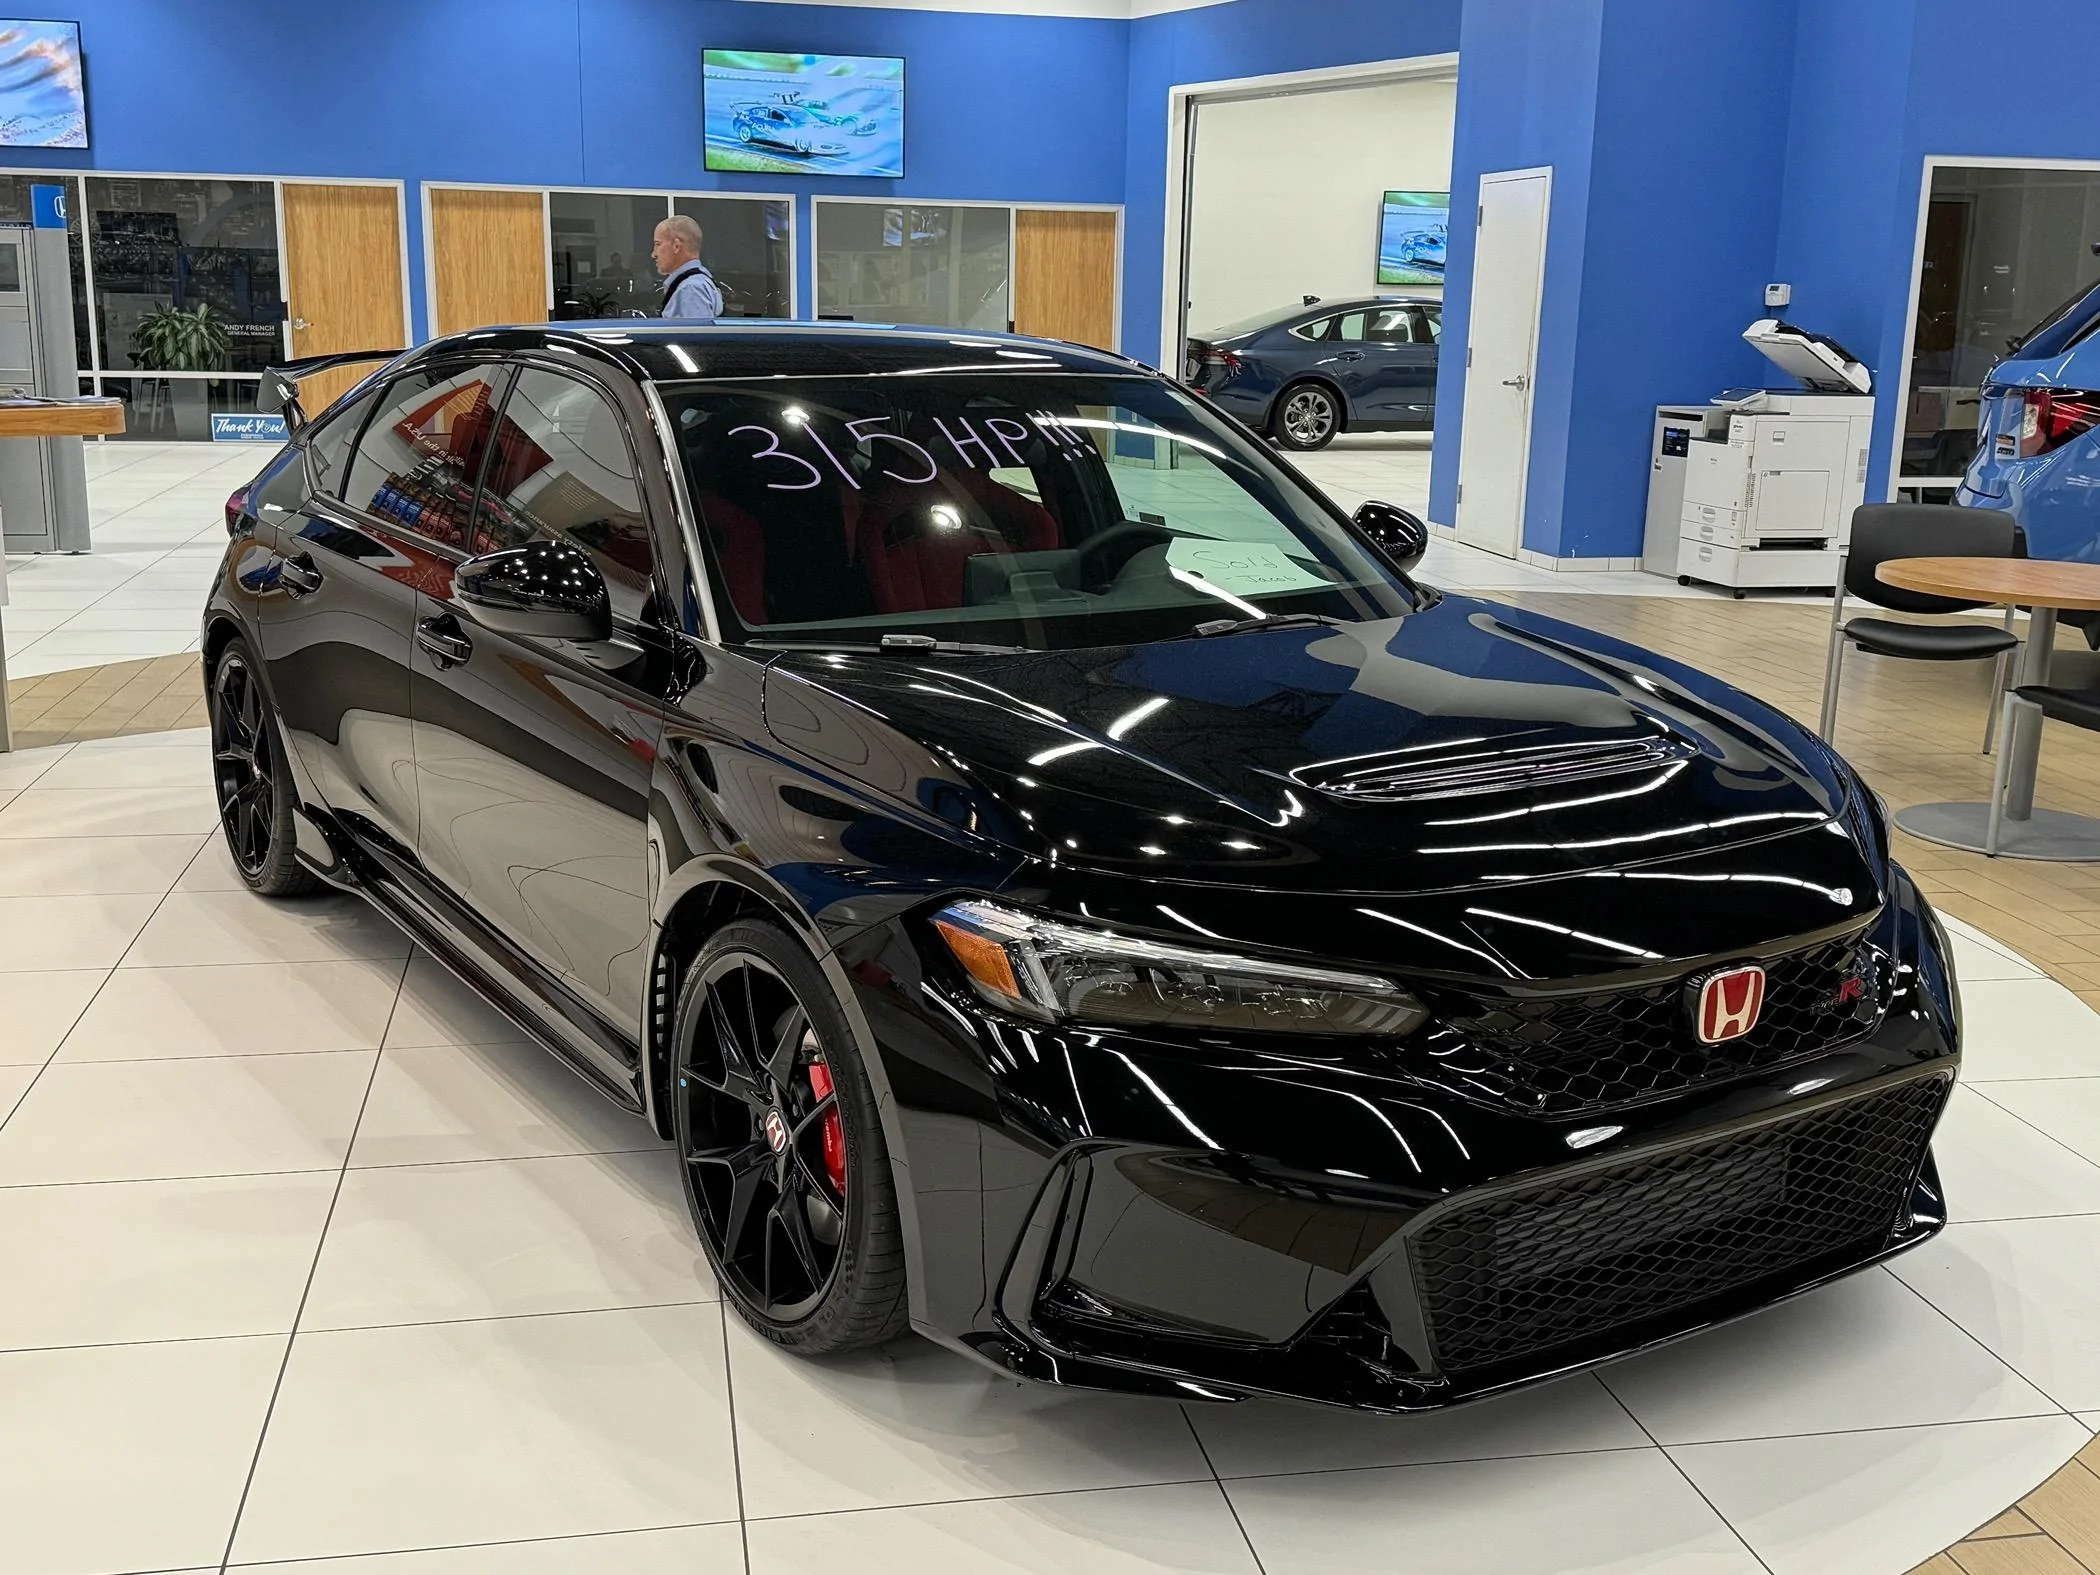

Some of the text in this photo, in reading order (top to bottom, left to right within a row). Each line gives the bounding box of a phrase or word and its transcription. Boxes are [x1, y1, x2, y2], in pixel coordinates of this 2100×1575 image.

[246, 324, 275, 332] FRENCH
[215, 418, 254, 433] Thank
[728, 411, 938, 490] 315
[1192, 550, 1279, 570] Sold
